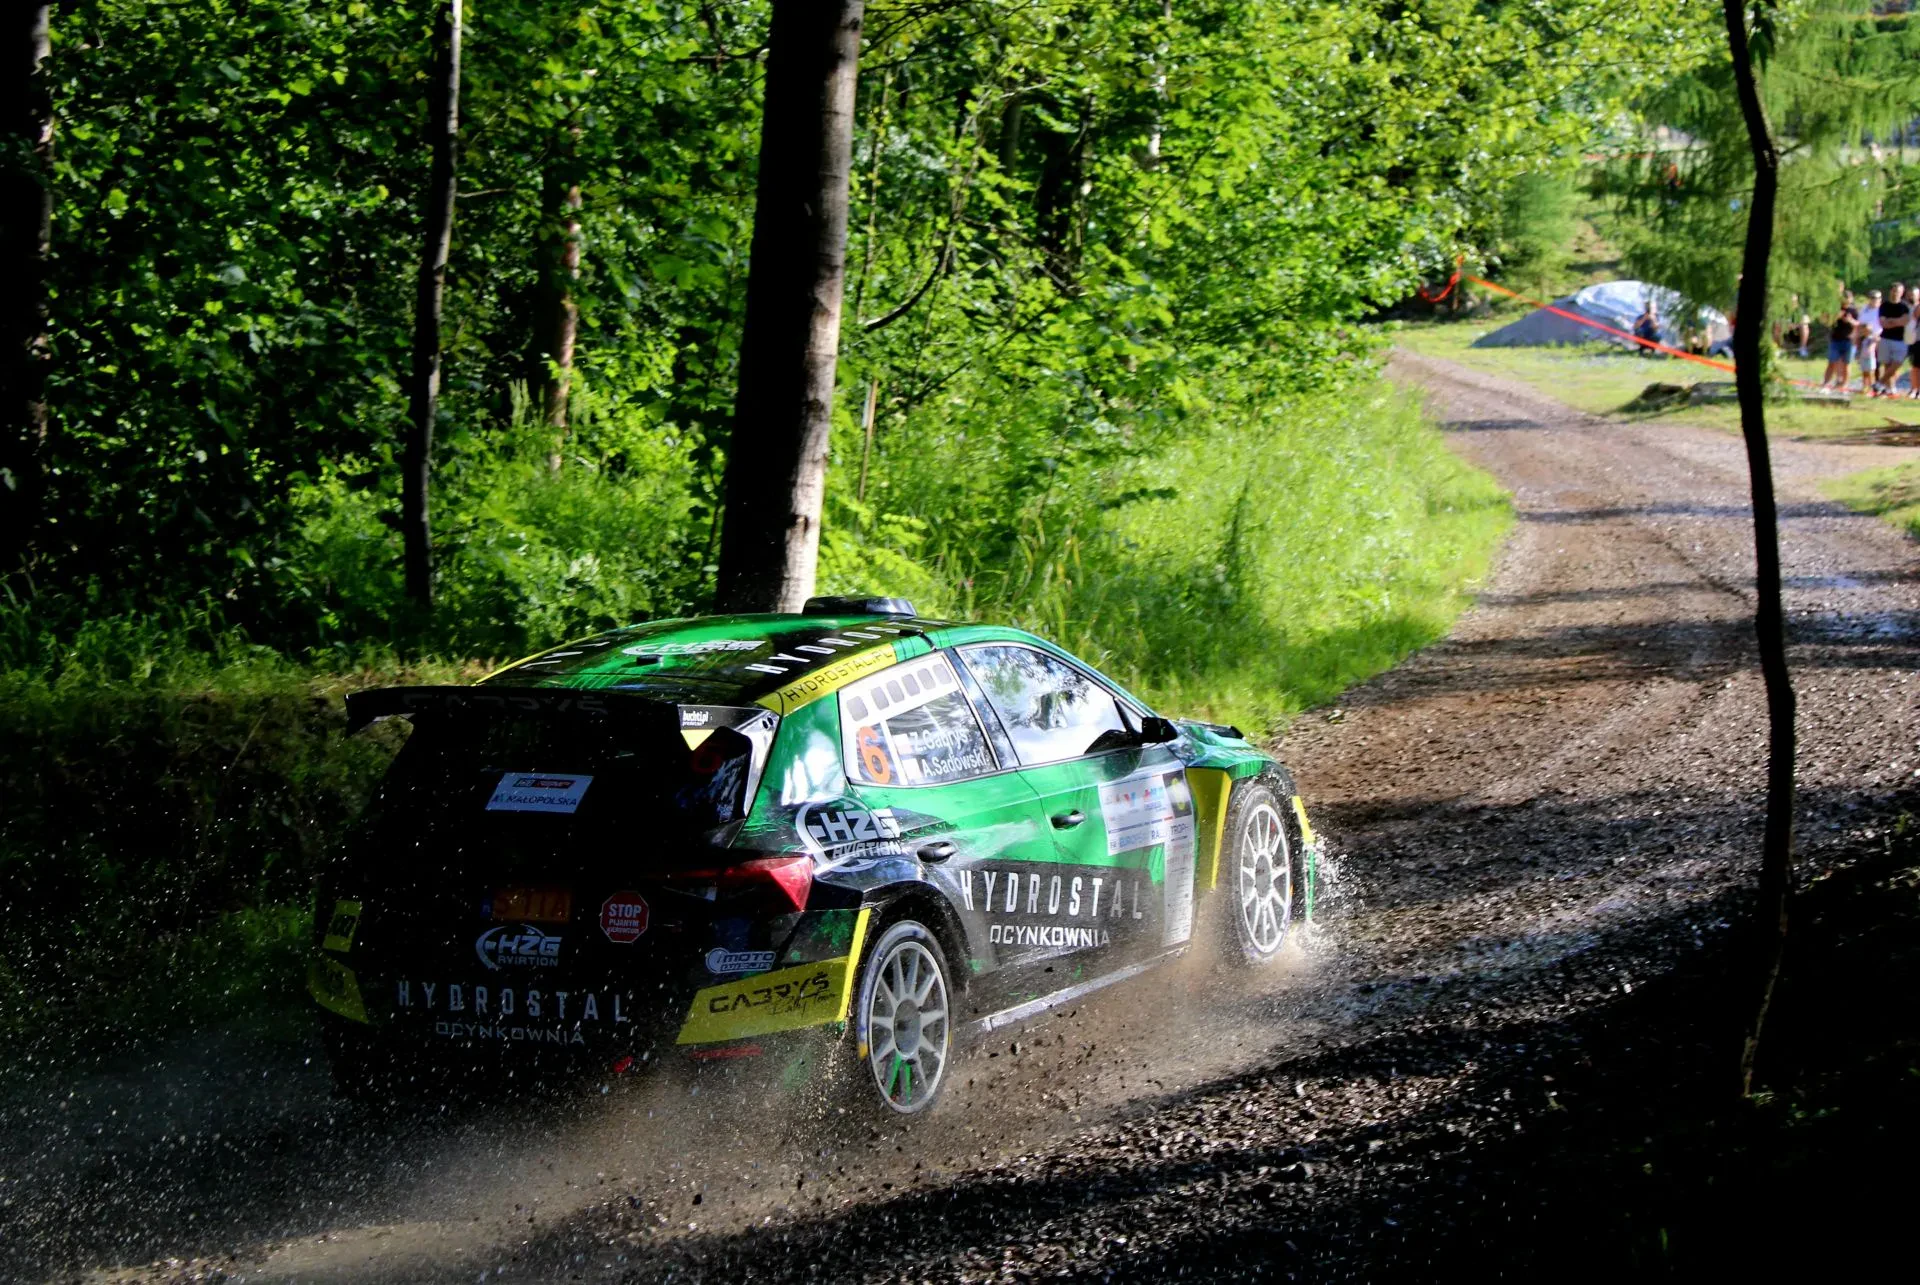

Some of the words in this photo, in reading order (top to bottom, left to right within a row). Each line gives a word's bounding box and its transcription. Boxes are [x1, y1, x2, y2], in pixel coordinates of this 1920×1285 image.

[857, 726, 892, 785] 6
[959, 869, 1143, 920] HYDROSTAL
[608, 903, 642, 919] STOP
[498, 933, 563, 957] HZG
[989, 924, 1110, 947] OCYNKOWNIA
[723, 952, 775, 963] MOTO
[396, 979, 629, 1024] HYDROSTAL
